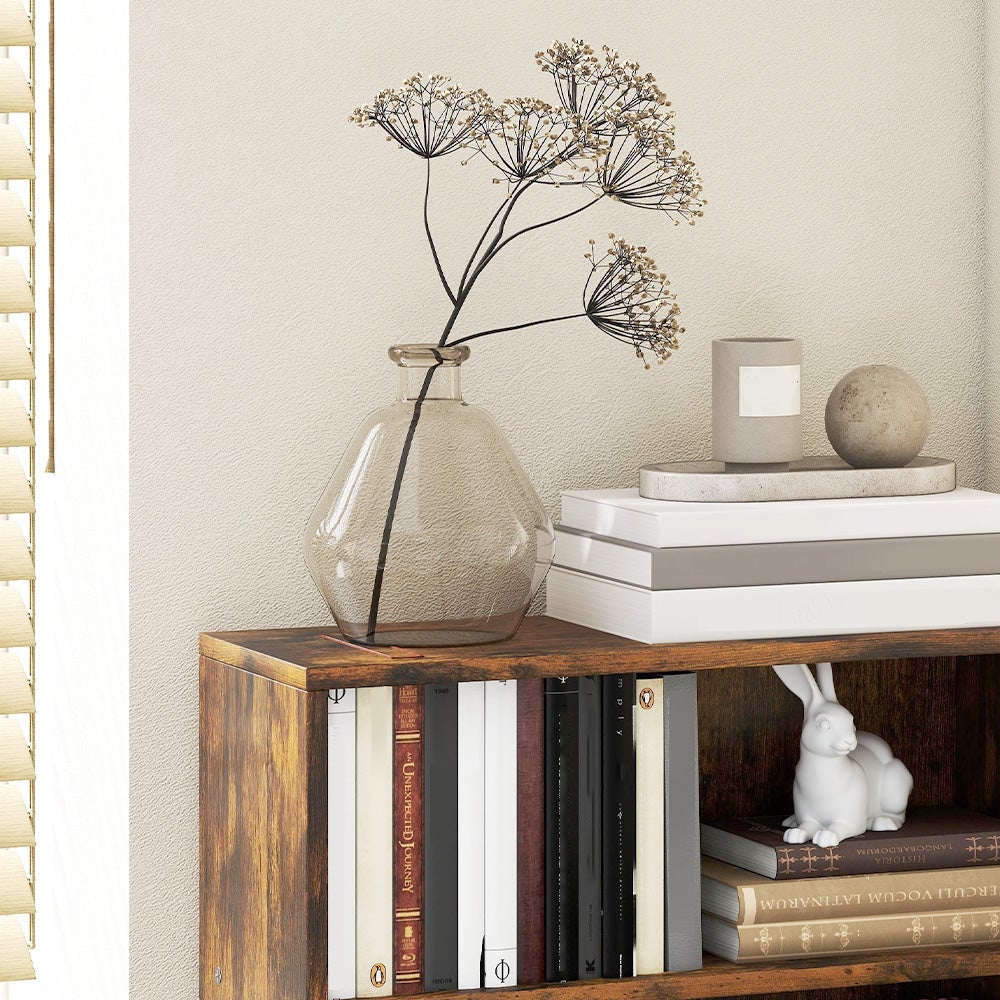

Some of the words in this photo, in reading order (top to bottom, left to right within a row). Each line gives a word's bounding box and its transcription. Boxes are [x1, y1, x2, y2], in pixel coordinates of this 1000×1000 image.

[402, 762, 415, 840] UNEXPECTED
[399, 841, 415, 893] JOURNEY
[874, 855, 926, 865] HISTORIA
[759, 893, 861, 910] LATINARUM
[868, 890, 934, 903] VOCUM
